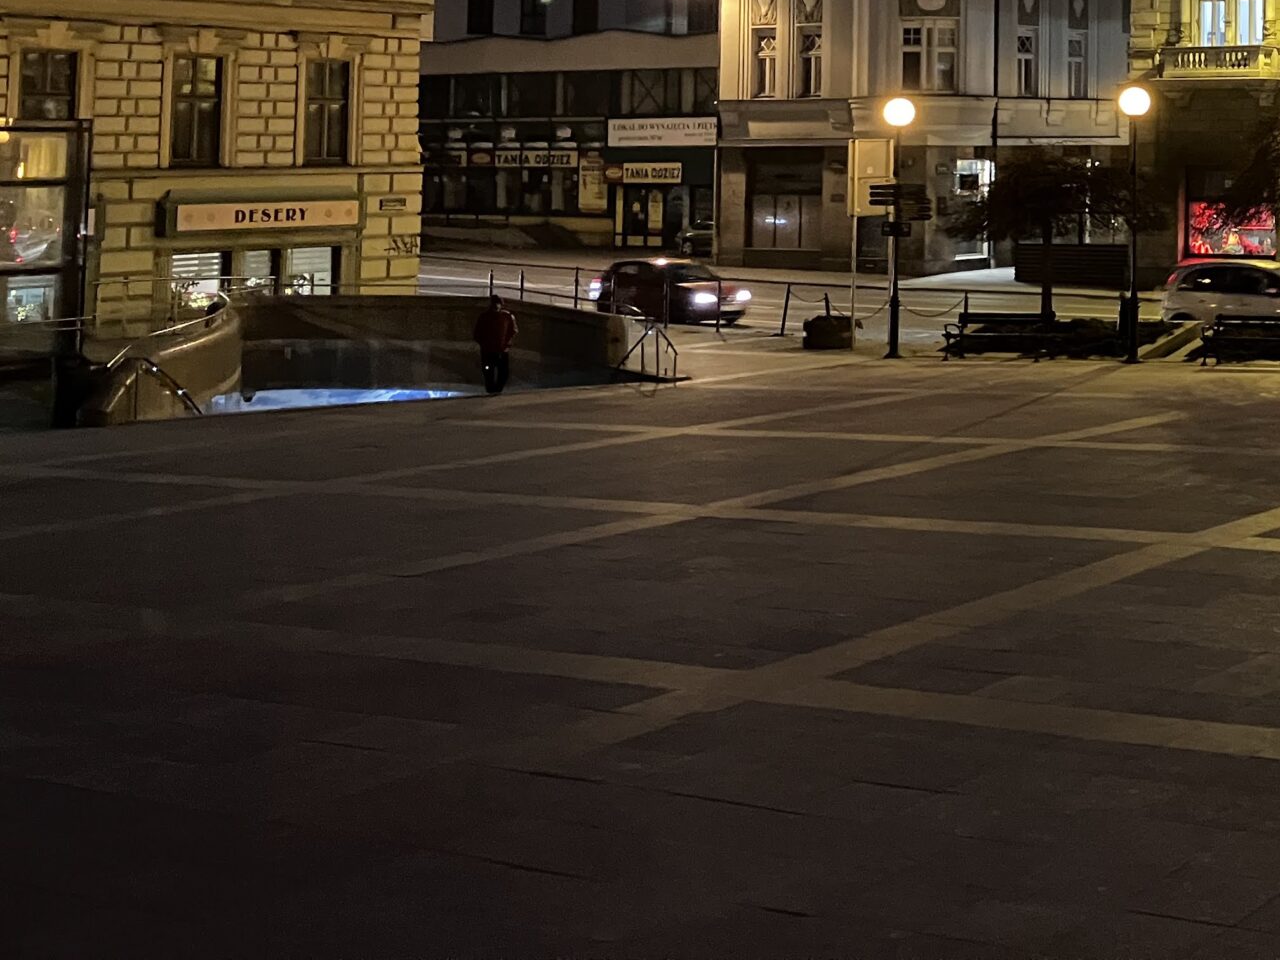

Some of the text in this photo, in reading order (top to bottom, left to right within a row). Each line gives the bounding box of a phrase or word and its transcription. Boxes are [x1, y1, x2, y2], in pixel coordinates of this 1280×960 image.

[496, 154, 530, 165] TANIA
[625, 167, 649, 179] TANIA
[234, 207, 309, 224] DESERY
